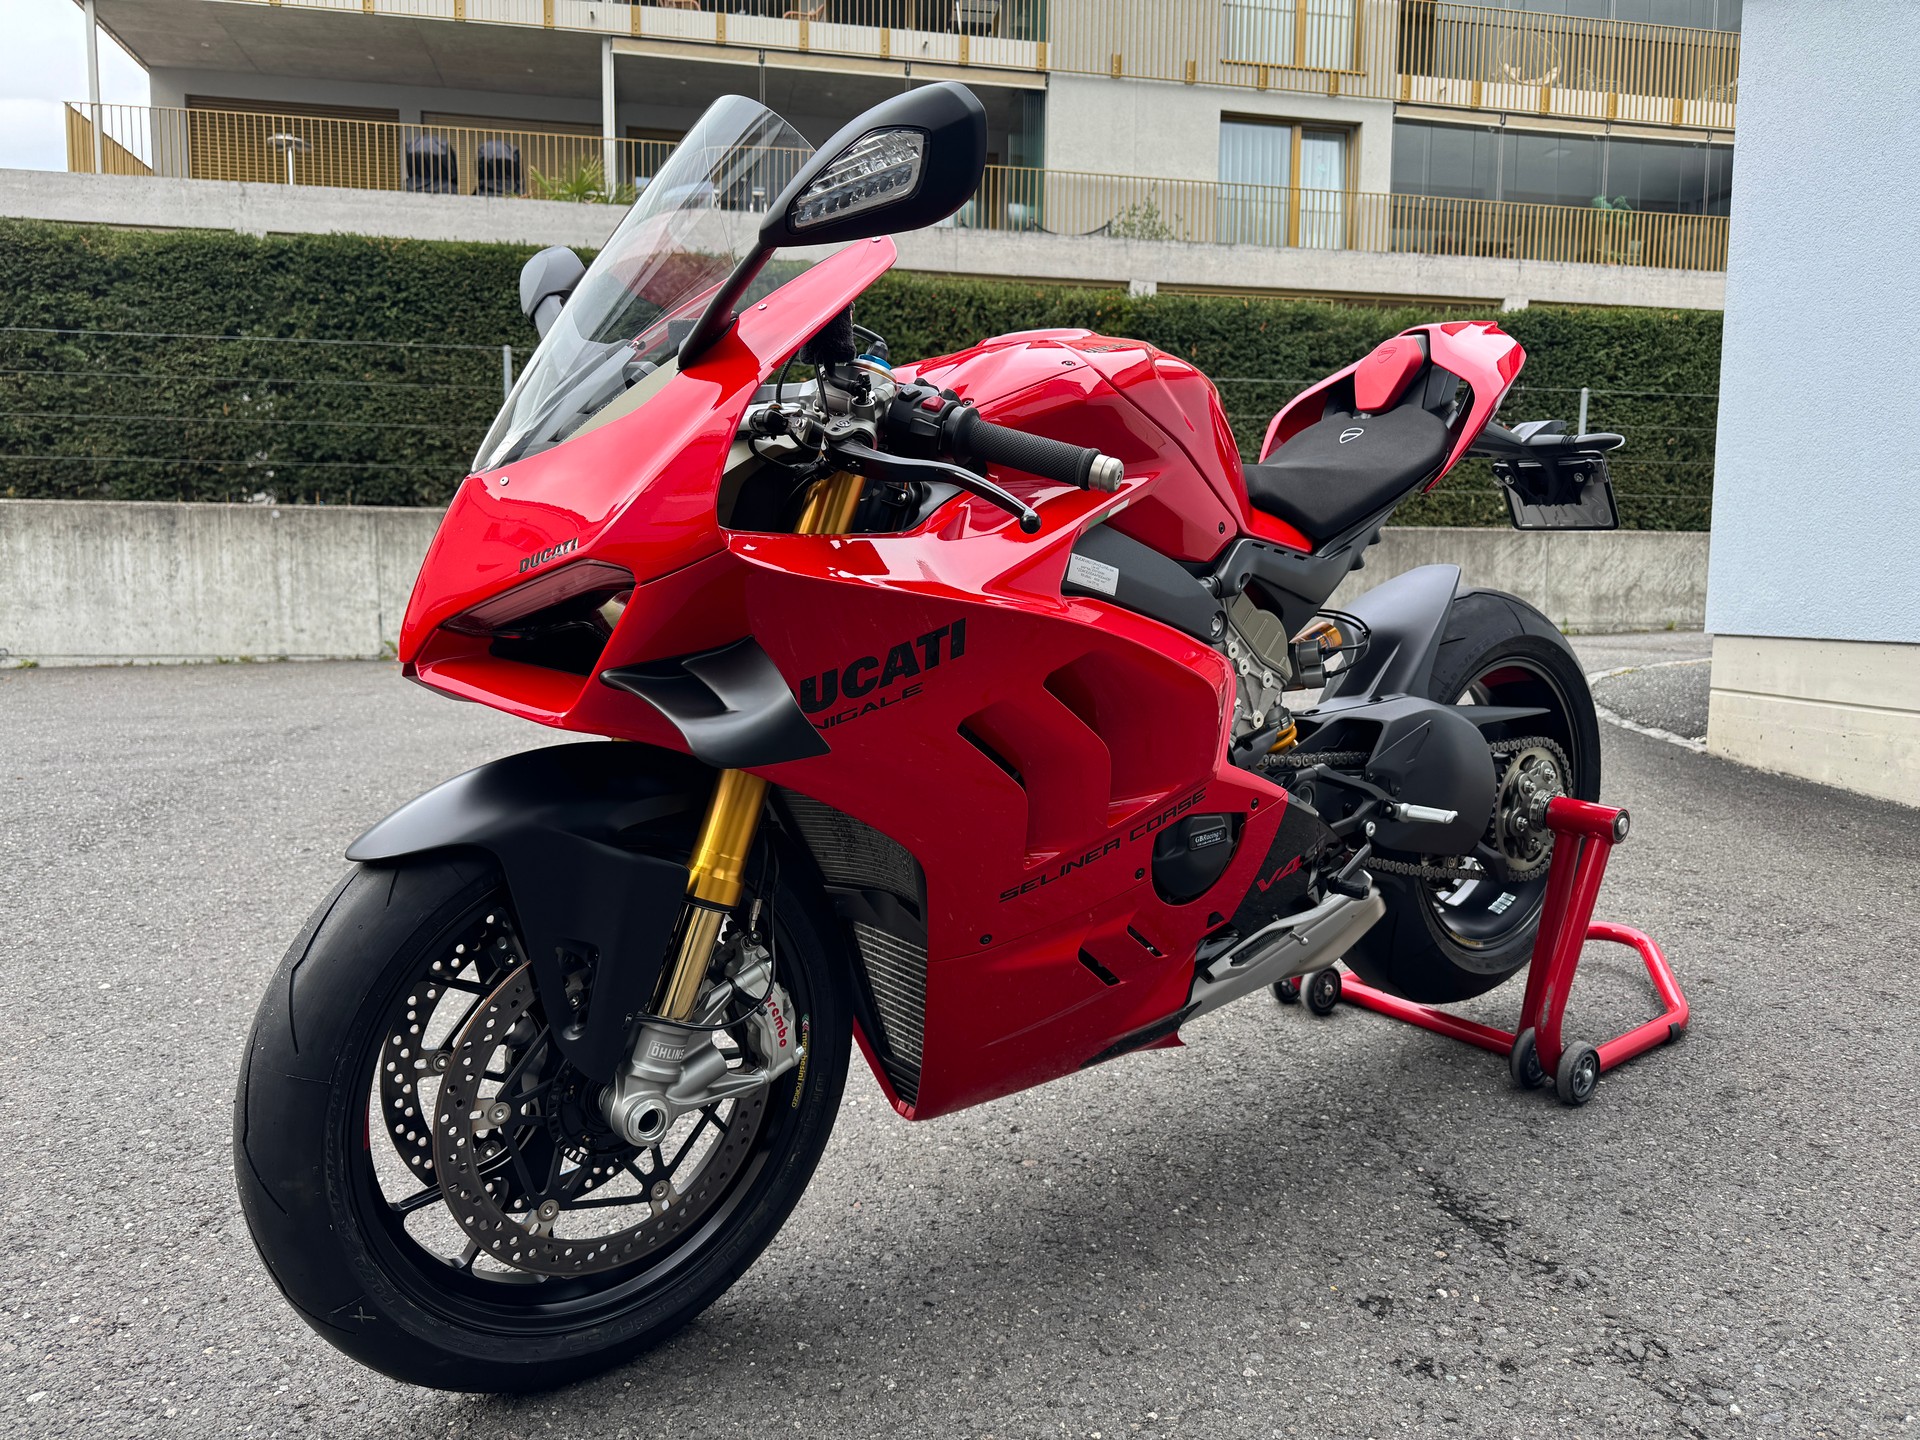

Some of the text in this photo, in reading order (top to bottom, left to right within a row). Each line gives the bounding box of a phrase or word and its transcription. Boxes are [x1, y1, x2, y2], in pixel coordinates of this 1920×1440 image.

[519, 536, 579, 573] DUCATI
[790, 617, 966, 714] UCATI
[813, 682, 924, 730] NIGALE
[999, 787, 1207, 903] SELINER CORSE
[1256, 854, 1303, 892] V4
[766, 995, 788, 1047] rembo
[651, 1042, 685, 1060] ÖHLINS
